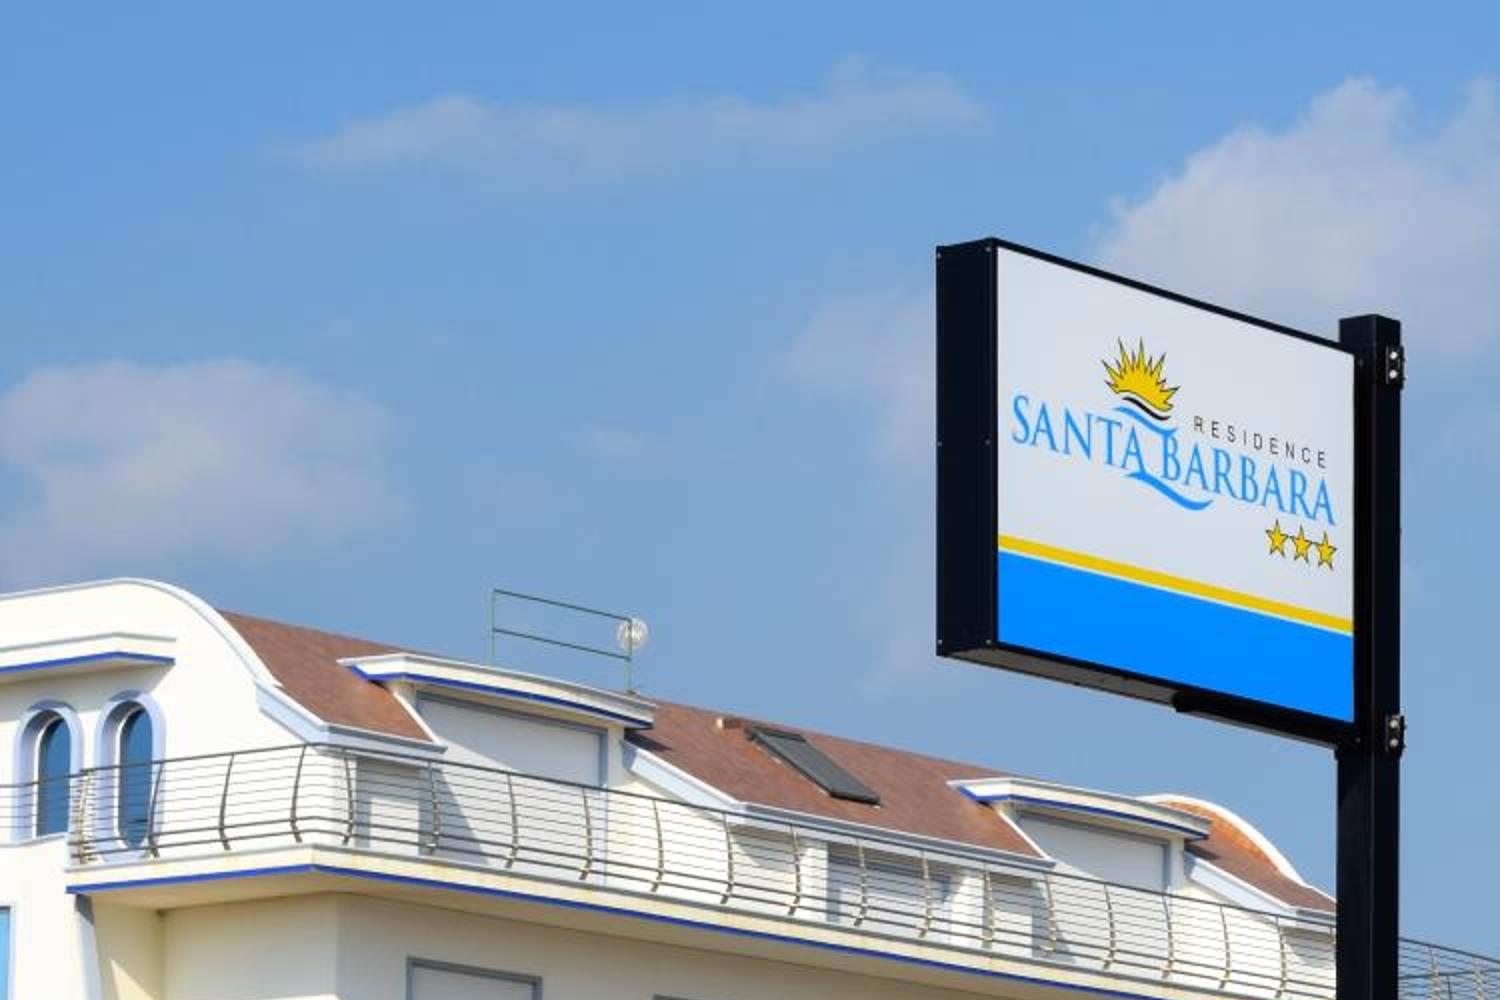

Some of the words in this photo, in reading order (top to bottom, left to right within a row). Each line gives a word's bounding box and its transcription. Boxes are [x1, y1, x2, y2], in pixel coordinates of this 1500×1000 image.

[1012, 395, 1147, 474] SANTA
[1160, 432, 1336, 526] BARBARA
[1193, 416, 1327, 469] RESIDENCE
